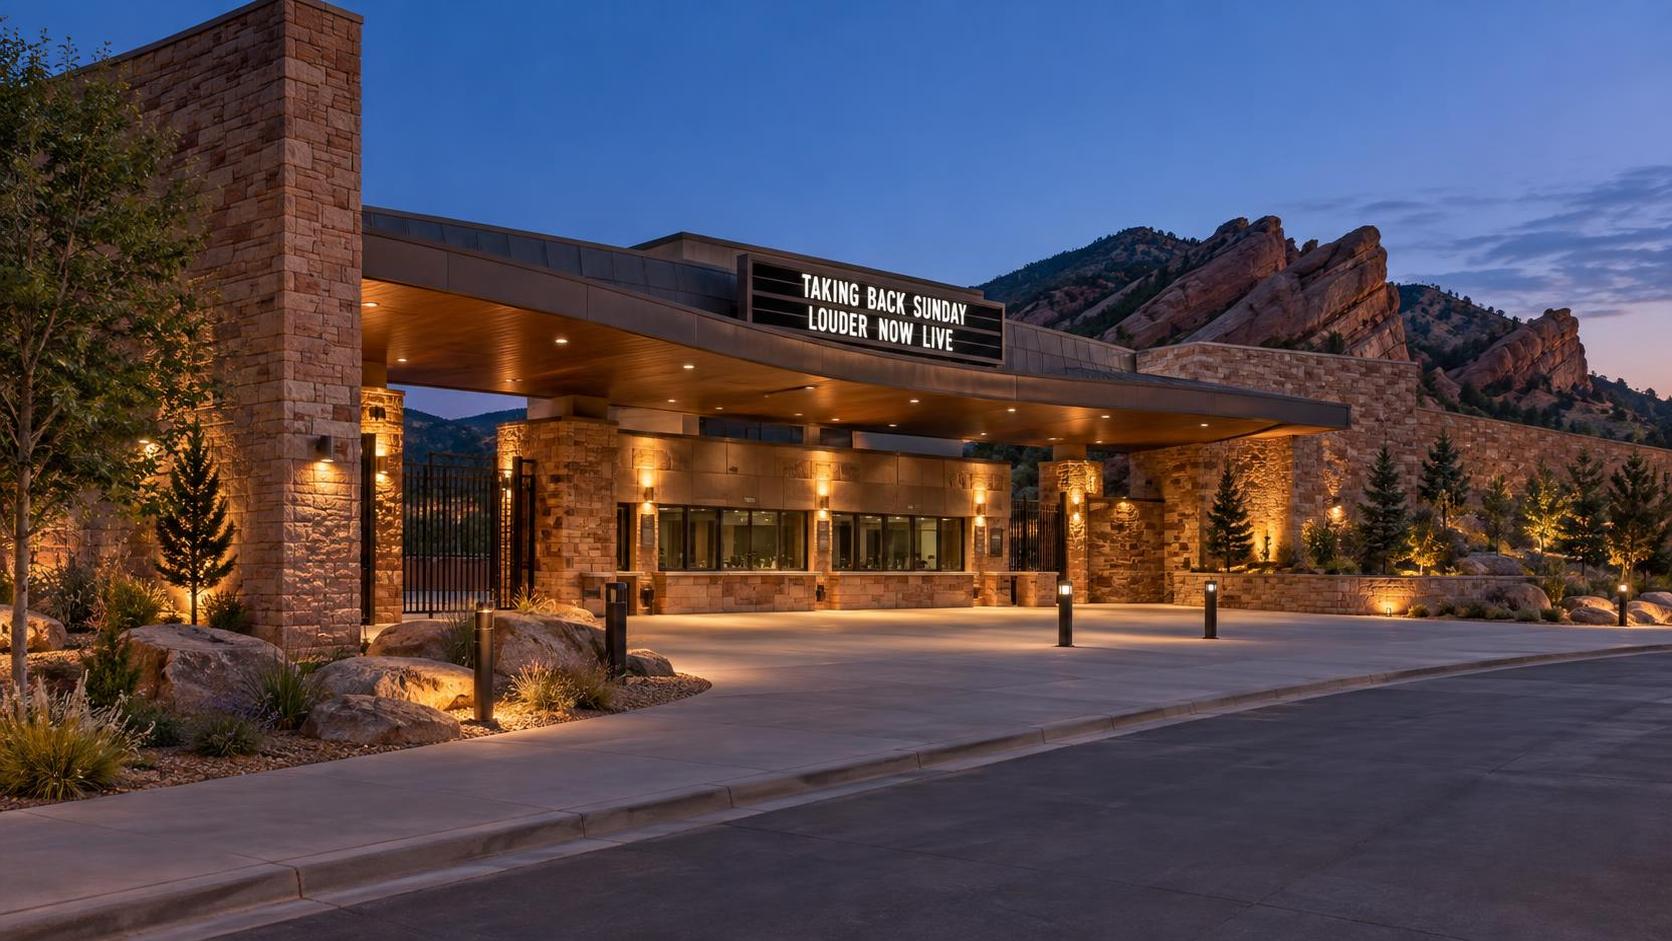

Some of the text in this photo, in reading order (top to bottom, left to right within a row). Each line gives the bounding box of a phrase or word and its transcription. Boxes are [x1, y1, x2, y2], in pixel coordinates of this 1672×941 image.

[801, 273, 967, 325] TAKING BACK SUNDAY
[808, 305, 954, 351] LOUDER NOW LIVE
